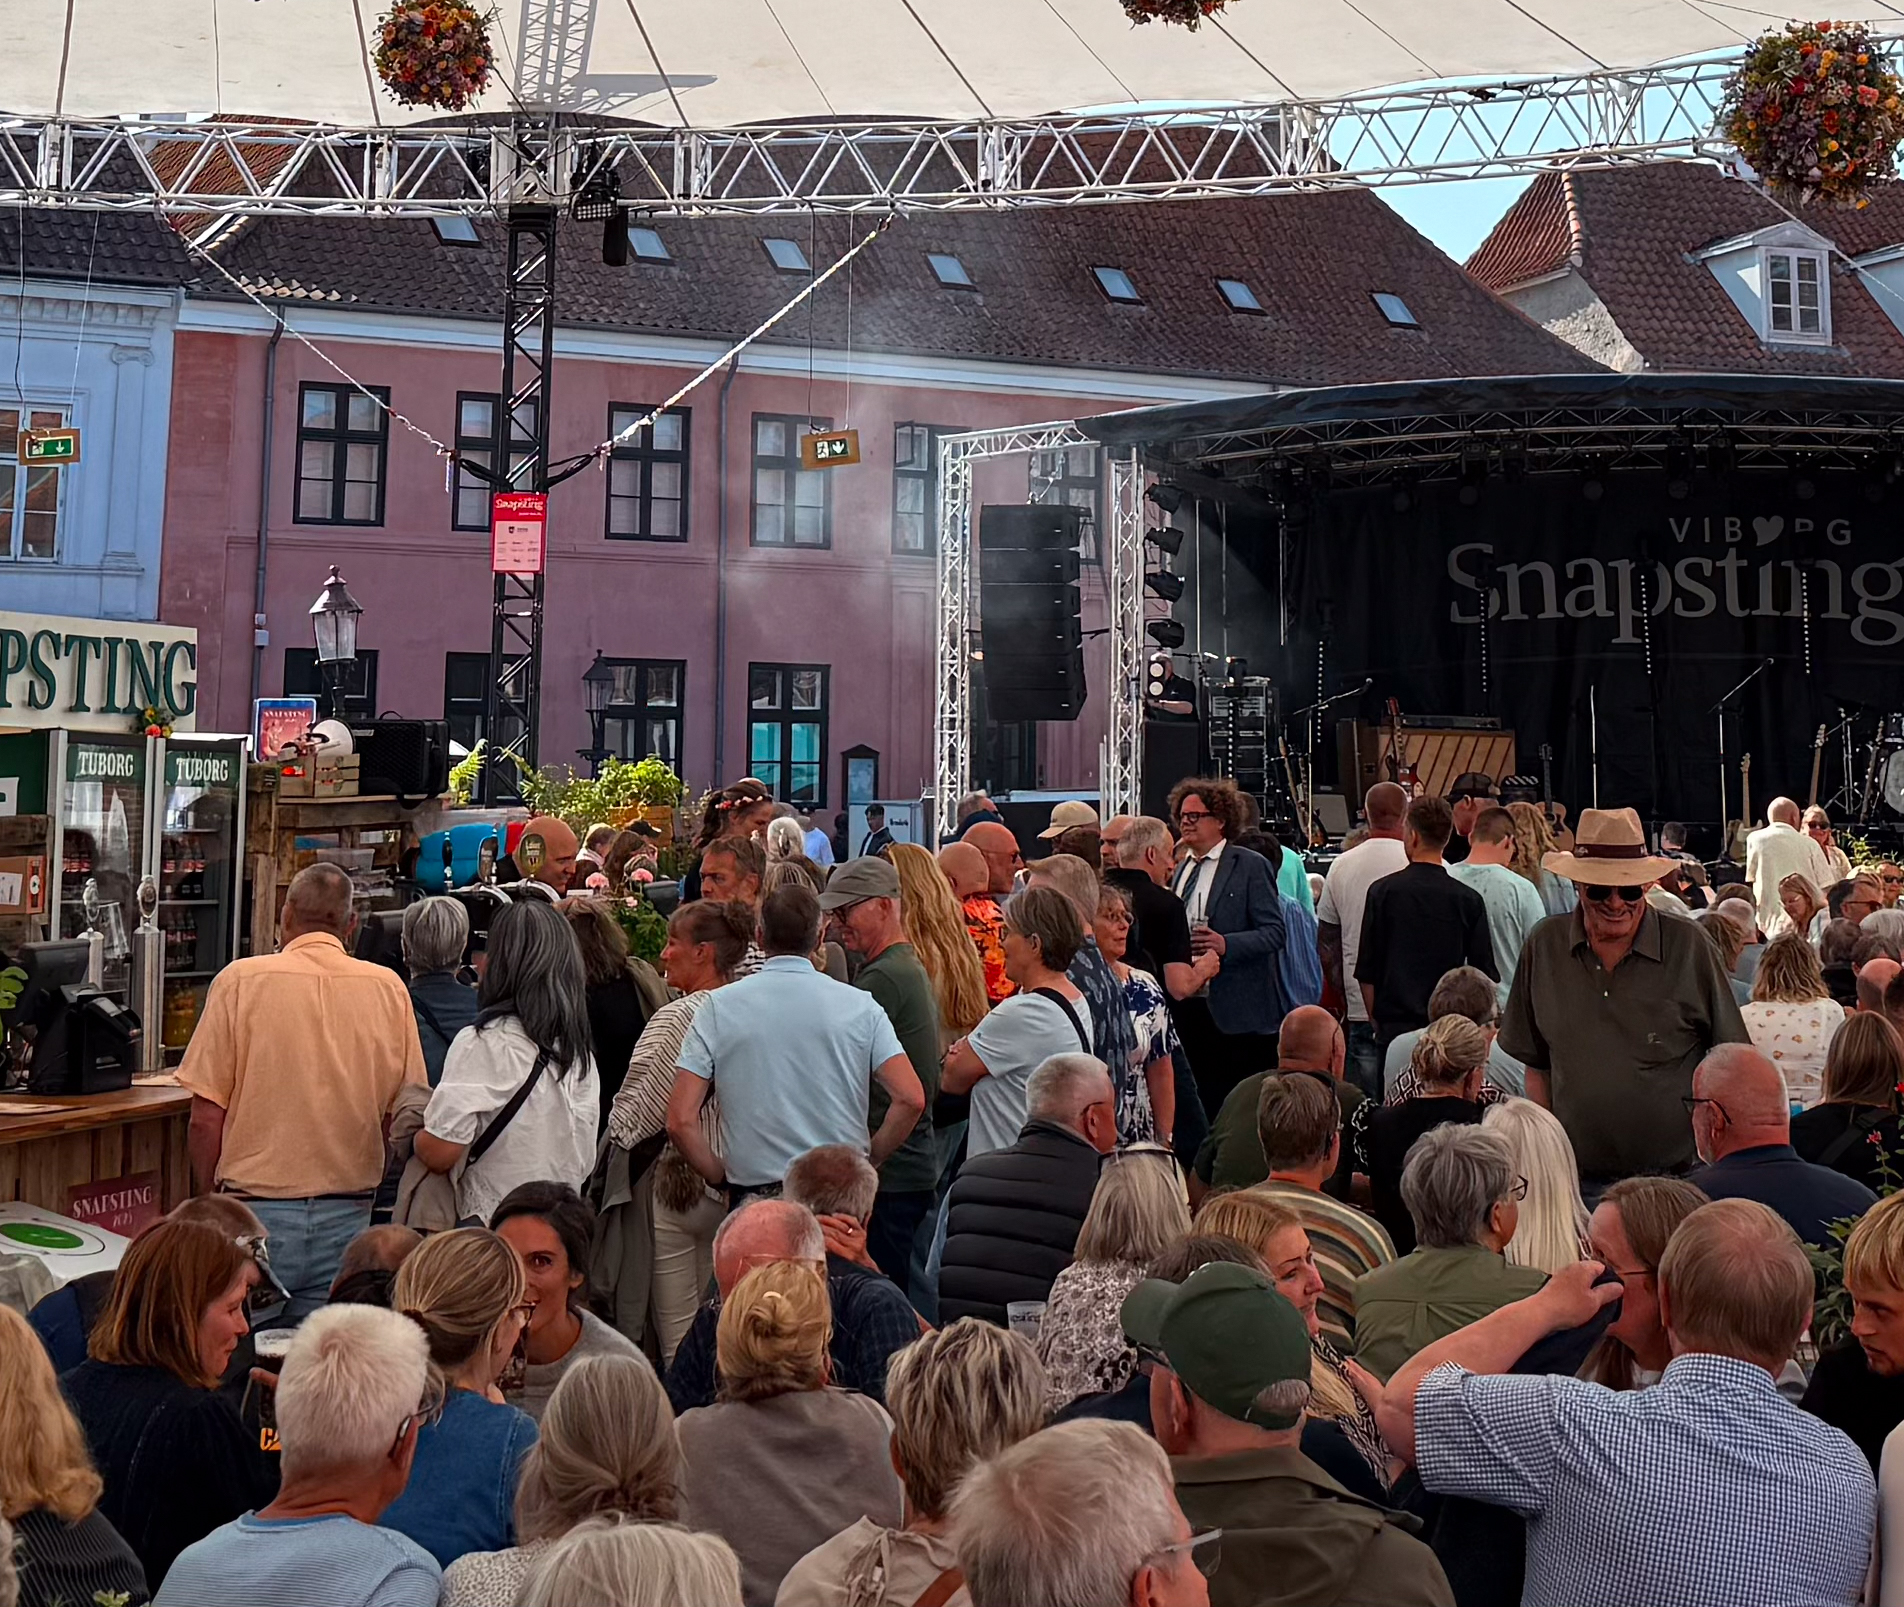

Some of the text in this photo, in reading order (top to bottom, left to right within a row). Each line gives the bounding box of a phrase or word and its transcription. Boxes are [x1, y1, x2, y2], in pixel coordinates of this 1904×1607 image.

[79, 751, 134, 777] TUBORG
[176, 757, 229, 782] TUBORG
[72, 1186, 152, 1219] SNAPSTING
